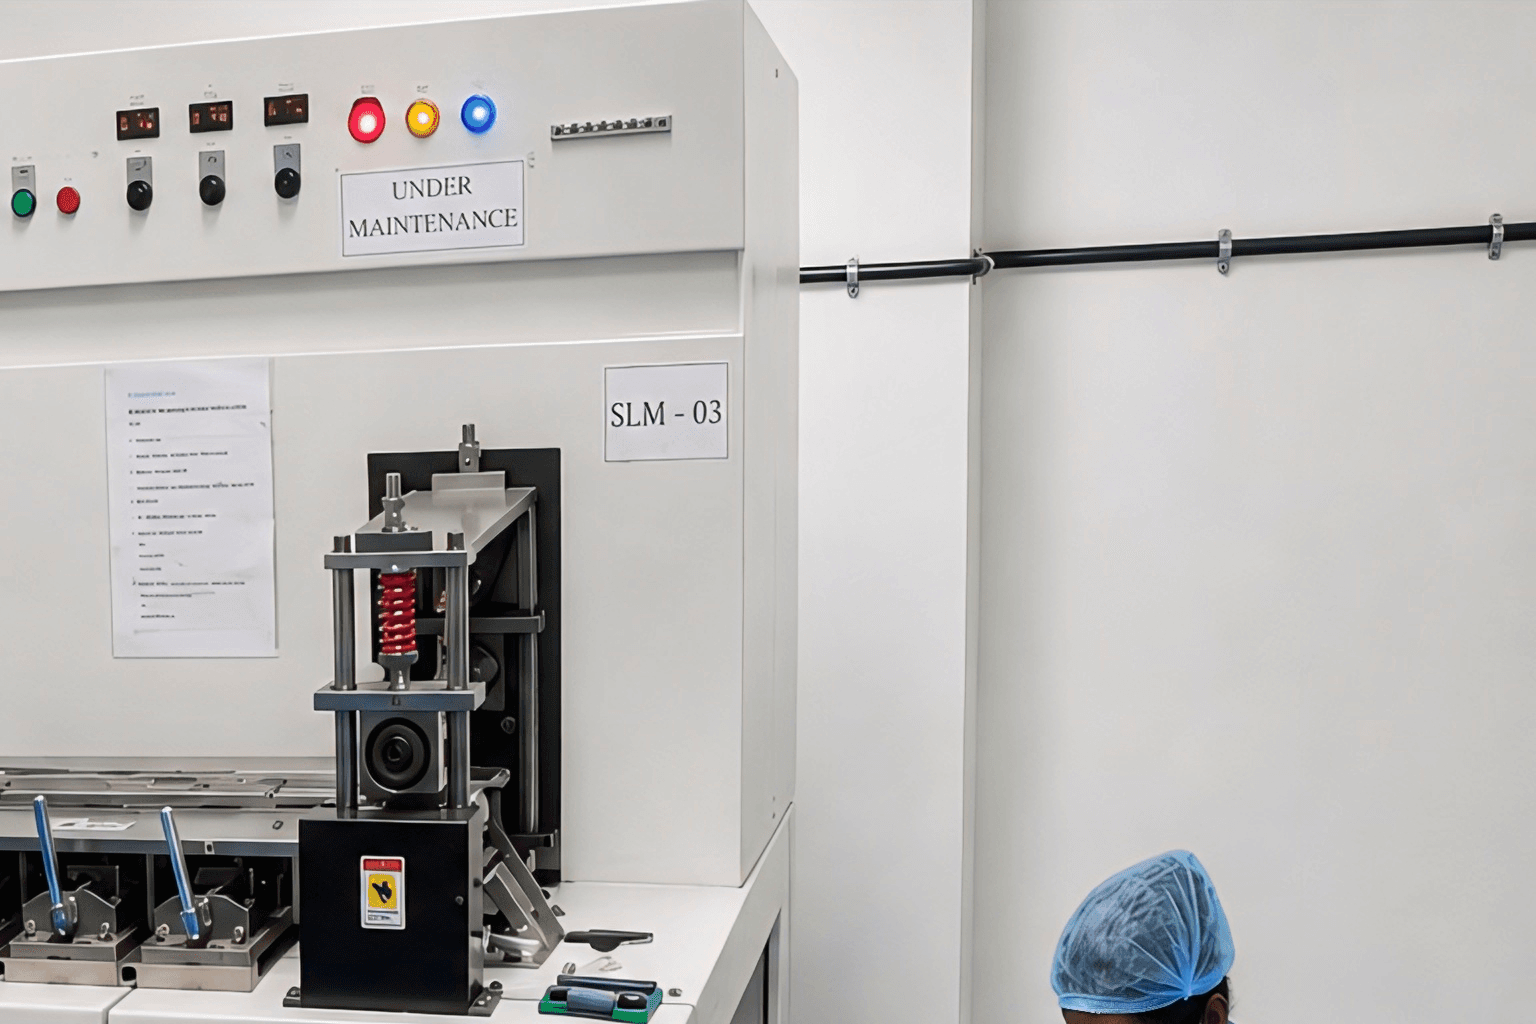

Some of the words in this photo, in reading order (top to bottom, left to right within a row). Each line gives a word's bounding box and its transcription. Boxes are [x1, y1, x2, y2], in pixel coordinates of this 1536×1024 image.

[392, 176, 472, 200] UNDER
[349, 208, 518, 238] MAINTENANCE
[611, 401, 665, 428] SLM
[693, 399, 722, 425] 03
